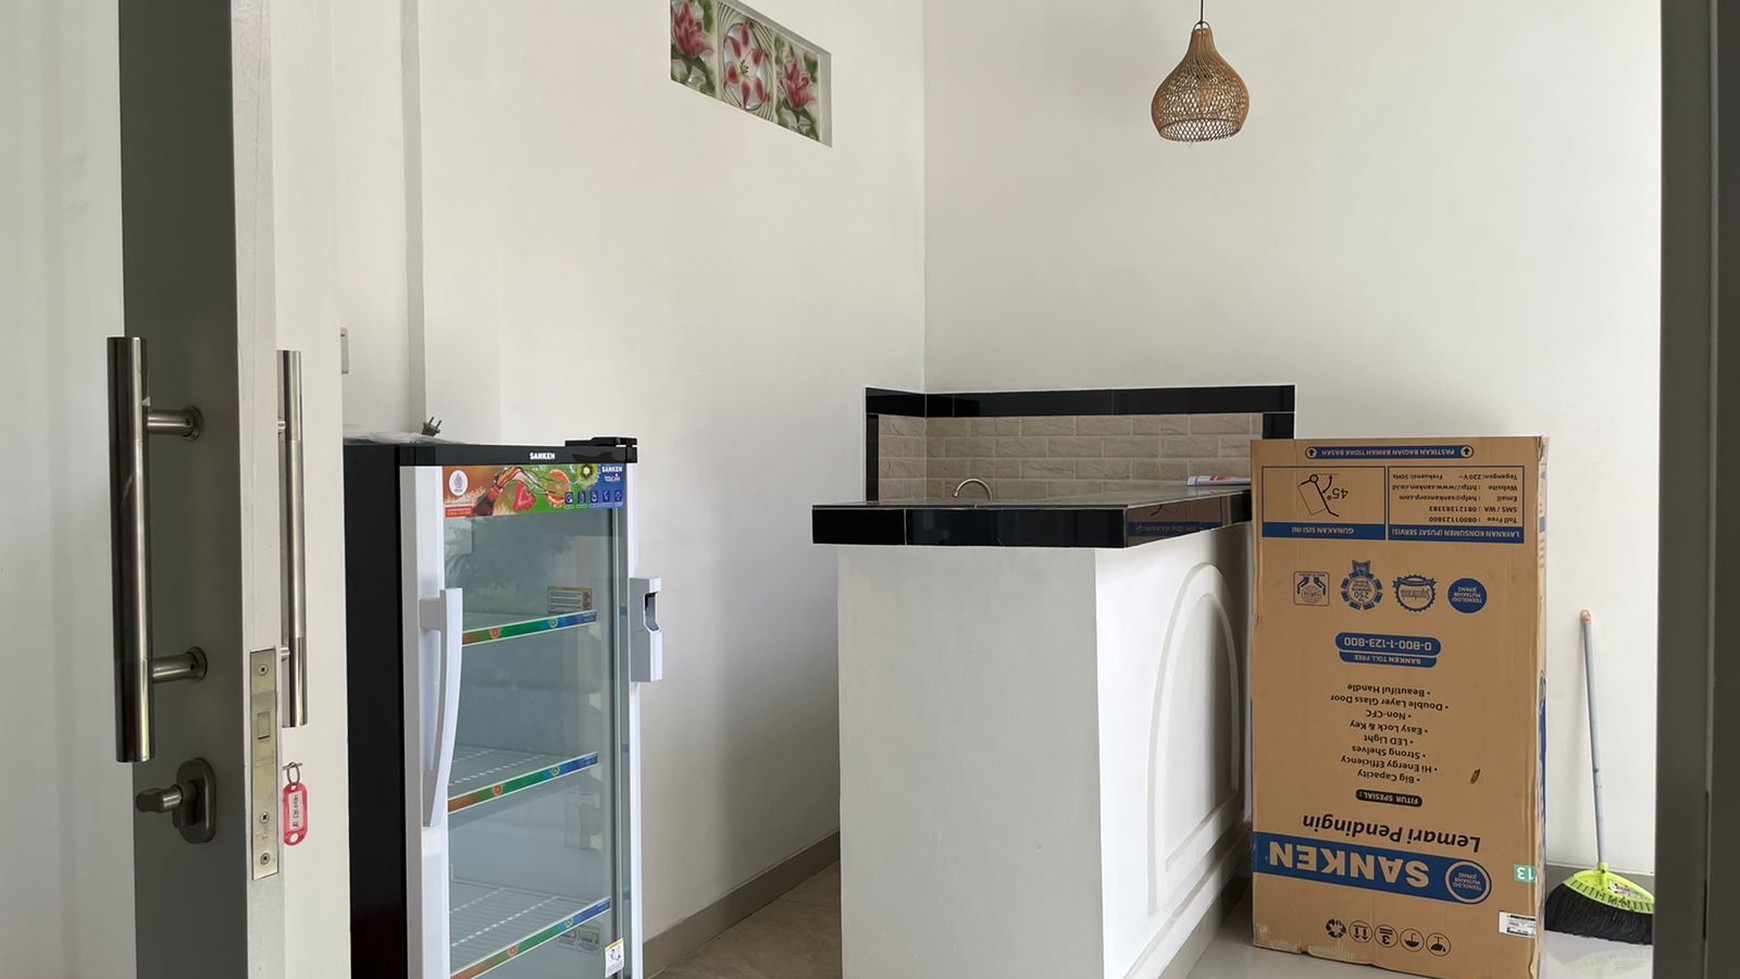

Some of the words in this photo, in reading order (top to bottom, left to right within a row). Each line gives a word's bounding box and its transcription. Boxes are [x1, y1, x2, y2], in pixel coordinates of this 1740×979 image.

[1344, 637, 1432, 651] 0-800-1-123-800
[1388, 656, 1421, 664] SANKEN
[1347, 684, 1380, 693] Handle
[1382, 687, 1424, 697] Beautiful
[1355, 697, 1378, 705] Glass
[1381, 698, 1406, 707] Layer
[1408, 701, 1442, 711] Double
[1366, 710, 1406, 720] Non-CFC
[1350, 721, 1366, 729] Key
[1378, 724, 1399, 732] Lock
[1401, 725, 1422, 734] Easy
[1364, 734, 1387, 744] Light
[1352, 746, 1387, 756] Shelves
[1389, 748, 1420, 759] Strong
[1340, 756, 1384, 768] Efficiency
[1387, 760, 1419, 771] Energy
[1357, 769, 1397, 781] Capacity
[1400, 774, 1414, 783] Big
[1395, 795, 1418, 804] FITUR
[1302, 814, 1402, 842] Pendingin
[1407, 828, 1480, 852] Lemari
[1268, 840, 1430, 888] SANKEN
[1382, 934, 1390, 944] 3
